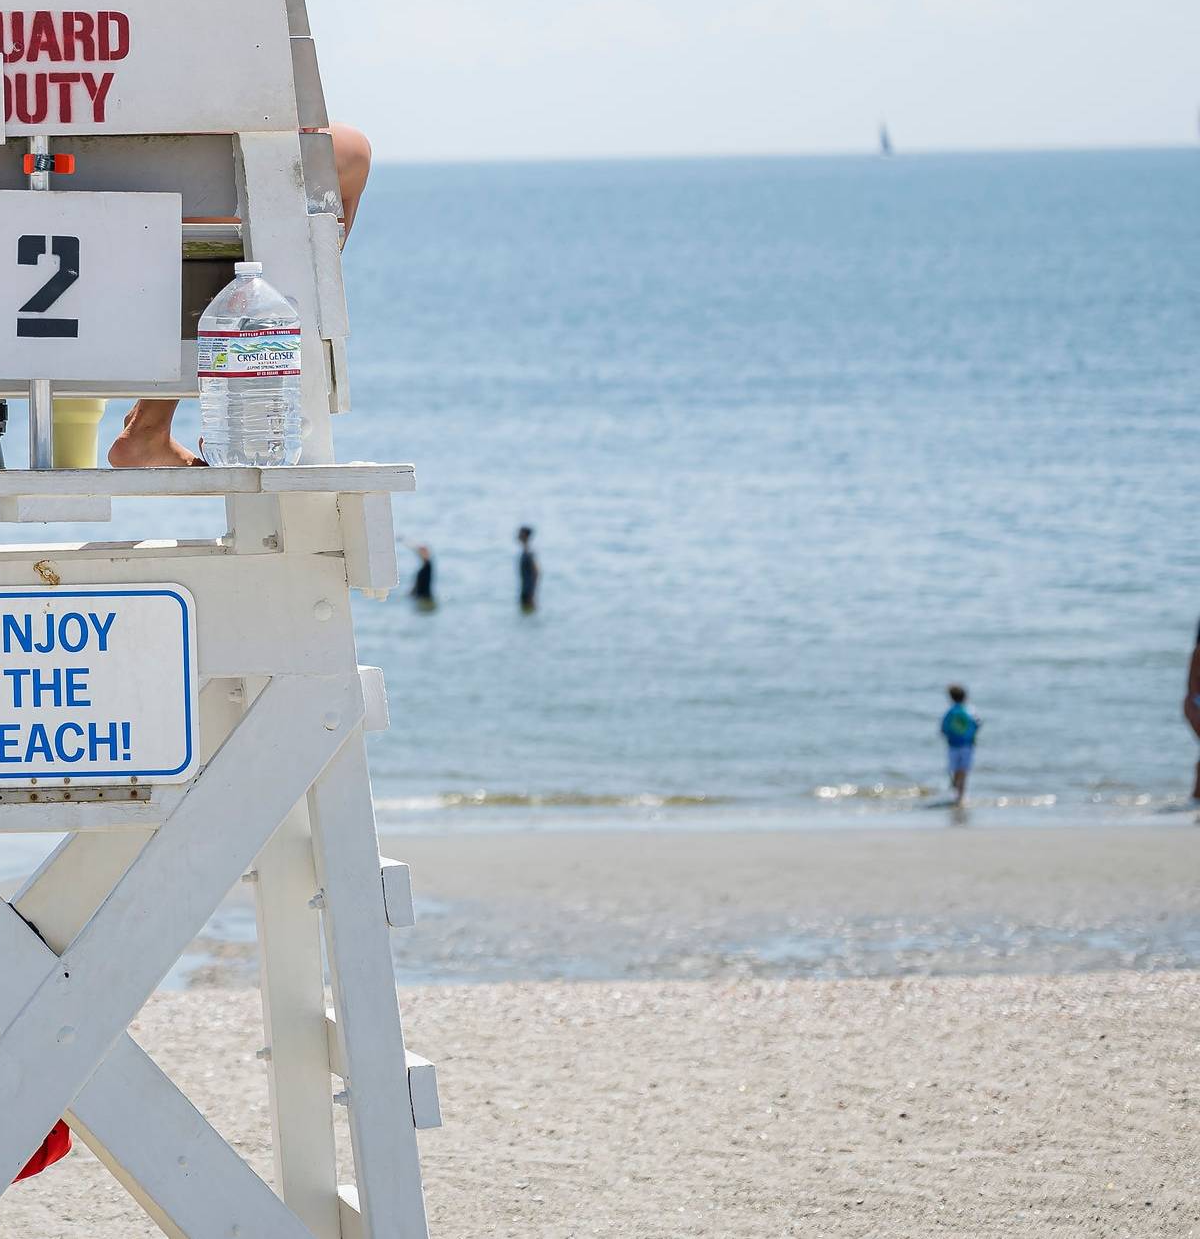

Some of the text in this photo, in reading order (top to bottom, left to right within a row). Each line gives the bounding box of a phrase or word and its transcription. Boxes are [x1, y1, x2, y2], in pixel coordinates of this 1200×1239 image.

[4, 72, 116, 125] UTY
[16, 235, 80, 338] 2
[237, 351, 295, 363] CRYSTAL GEYSER
[3, 667, 92, 708] THE
